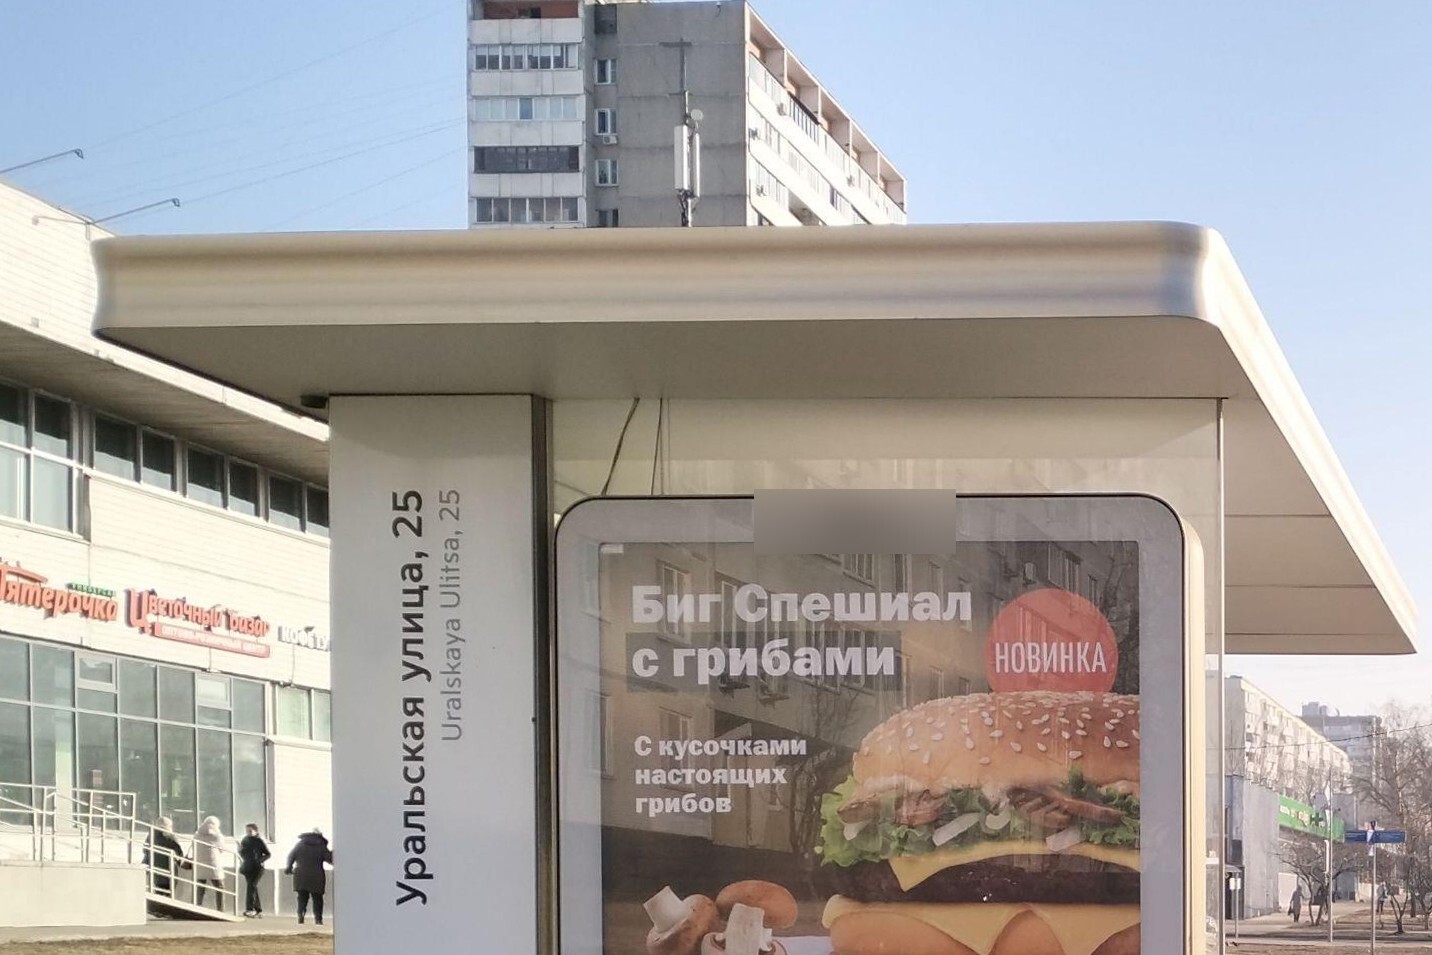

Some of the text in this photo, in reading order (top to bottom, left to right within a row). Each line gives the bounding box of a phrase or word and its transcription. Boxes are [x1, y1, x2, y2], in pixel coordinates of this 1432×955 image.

[439, 489, 466, 741] Uralskaya Ulitsa, 25
[632, 583, 972, 630] Биг Спешиал
[632, 632, 895, 684] с грибами
[994, 640, 1107, 675] НОВИНКА
[392, 490, 434, 905] Уральская улица, 25
[634, 736, 808, 761] С кусочками
[635, 768, 788, 788] настоящих
[635, 794, 732, 817] грибов
